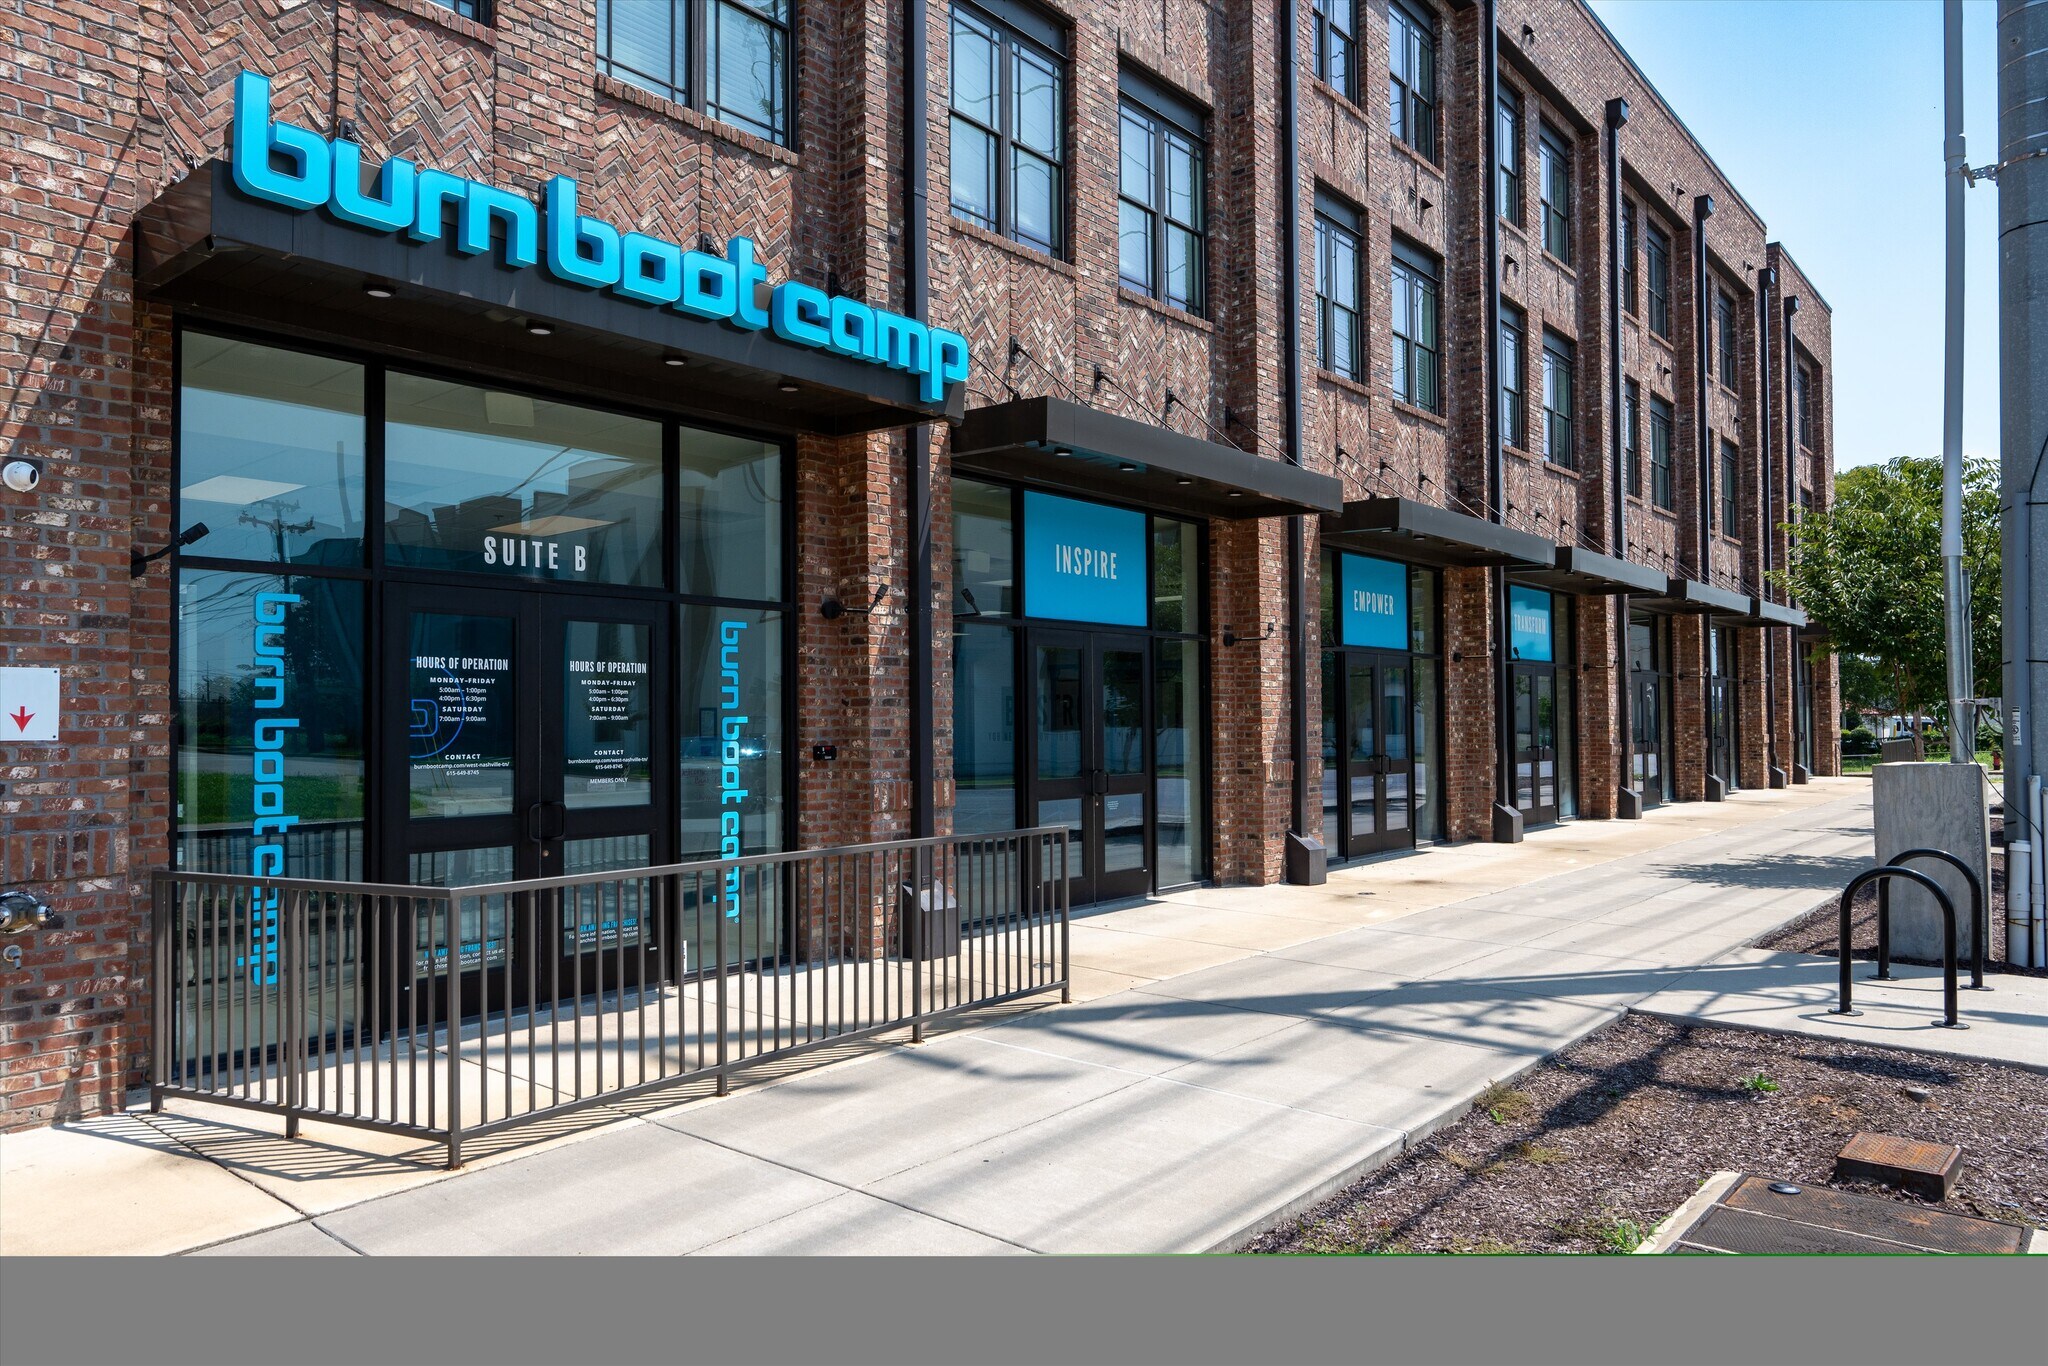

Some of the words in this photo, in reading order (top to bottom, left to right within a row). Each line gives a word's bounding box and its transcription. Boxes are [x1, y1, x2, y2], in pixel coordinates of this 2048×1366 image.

[233, 69, 538, 268] burn
[547, 174, 768, 331] boot
[772, 280, 968, 402] camp
[484, 536, 558, 570] SUITE
[574, 545, 586, 571] B
[1055, 543, 1117, 580] INSPIRE
[1353, 590, 1394, 616] EMPOWER
[1514, 613, 1547, 635] TRANSFORM
[254, 592, 300, 708] burn
[416, 656, 446, 669] HOURS
[448, 657, 460, 670] OF
[462, 657, 509, 671] OPERATION
[569, 660, 595, 672] HOURS
[596, 661, 606, 673] OF
[608, 662, 647, 674] OPERATION
[721, 621, 748, 710] burn
[253, 718, 300, 836] boot
[721, 716, 748, 805] boot
